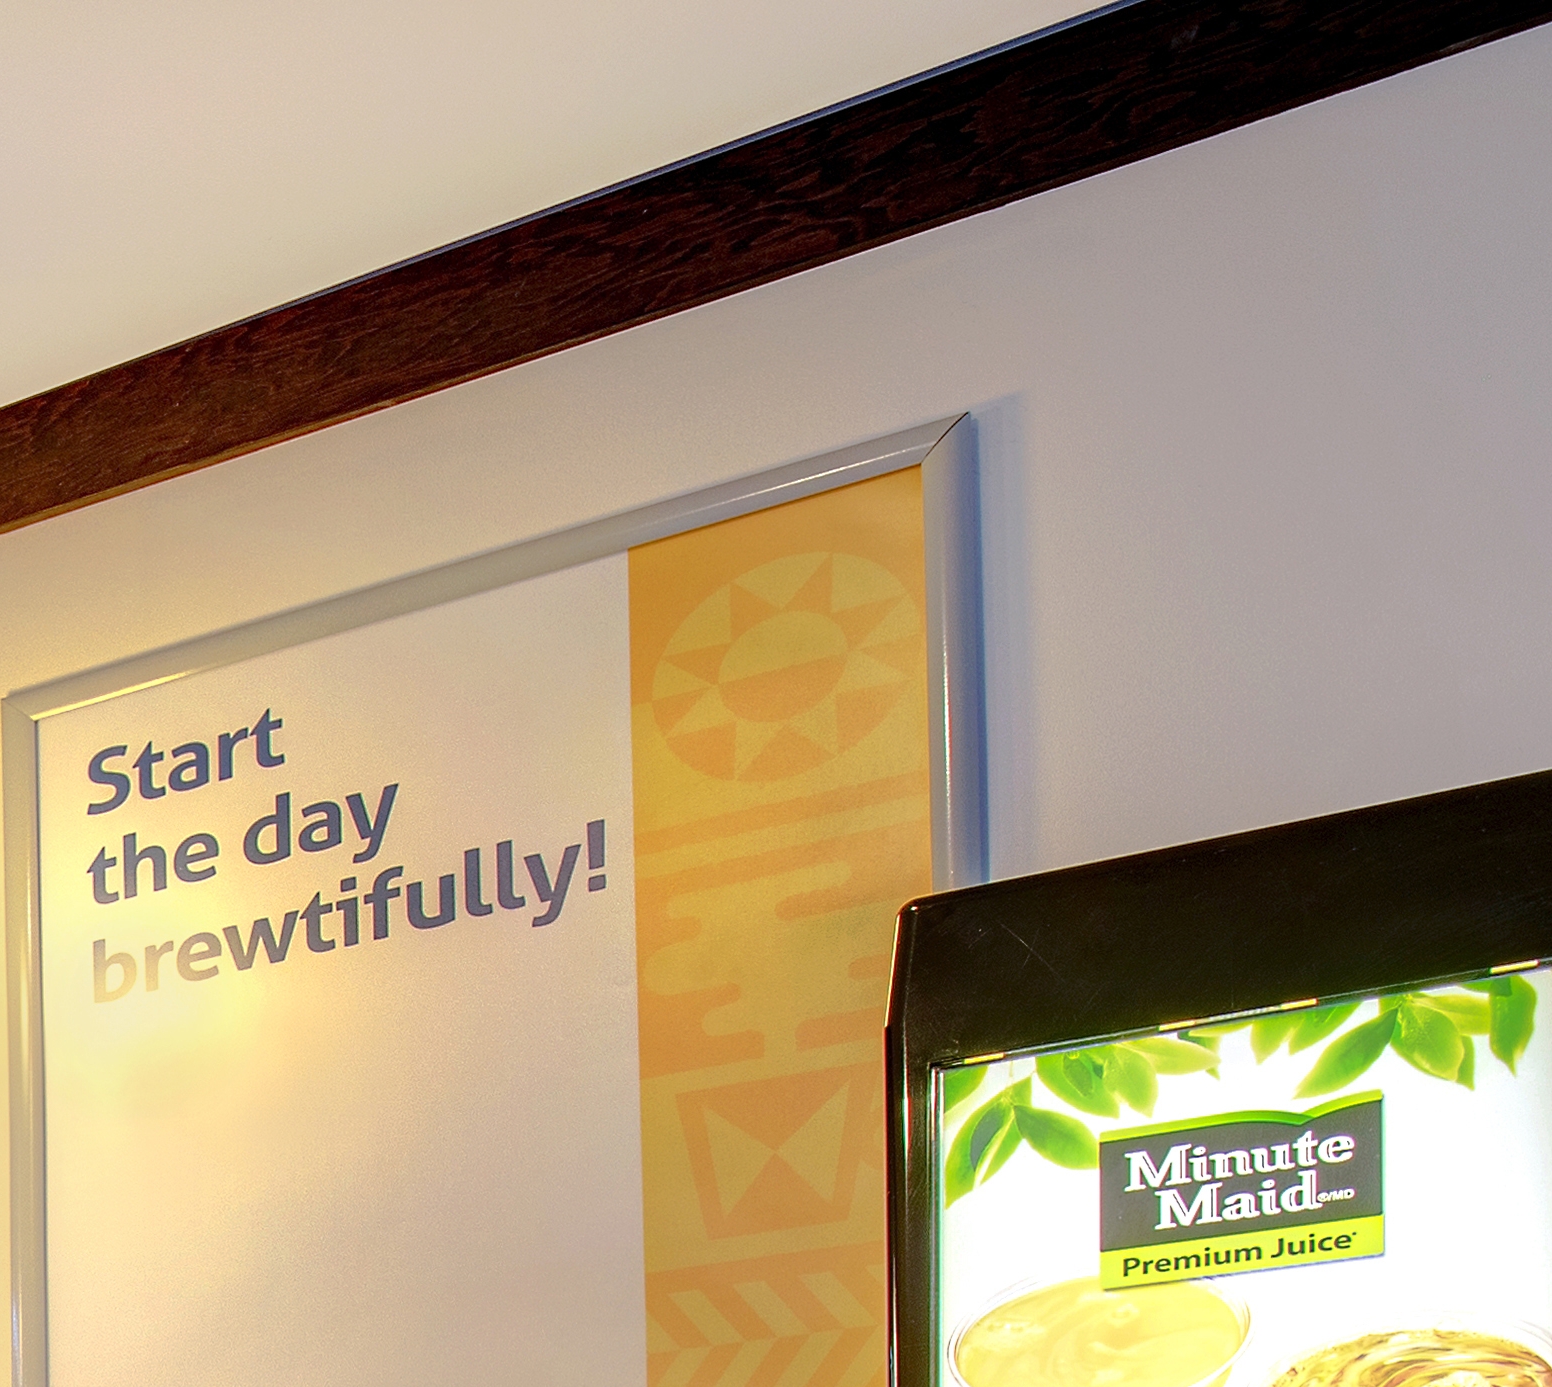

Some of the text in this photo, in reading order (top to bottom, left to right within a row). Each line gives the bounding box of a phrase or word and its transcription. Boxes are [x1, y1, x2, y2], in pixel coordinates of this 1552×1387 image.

[86, 708, 285, 815] Start
[86, 783, 399, 904] the day
[92, 819, 606, 1004] brewtifully!
[1123, 1130, 1356, 1192] Minute
[1154, 1169, 1323, 1231] Maid
[1122, 1243, 1263, 1277] Premium
